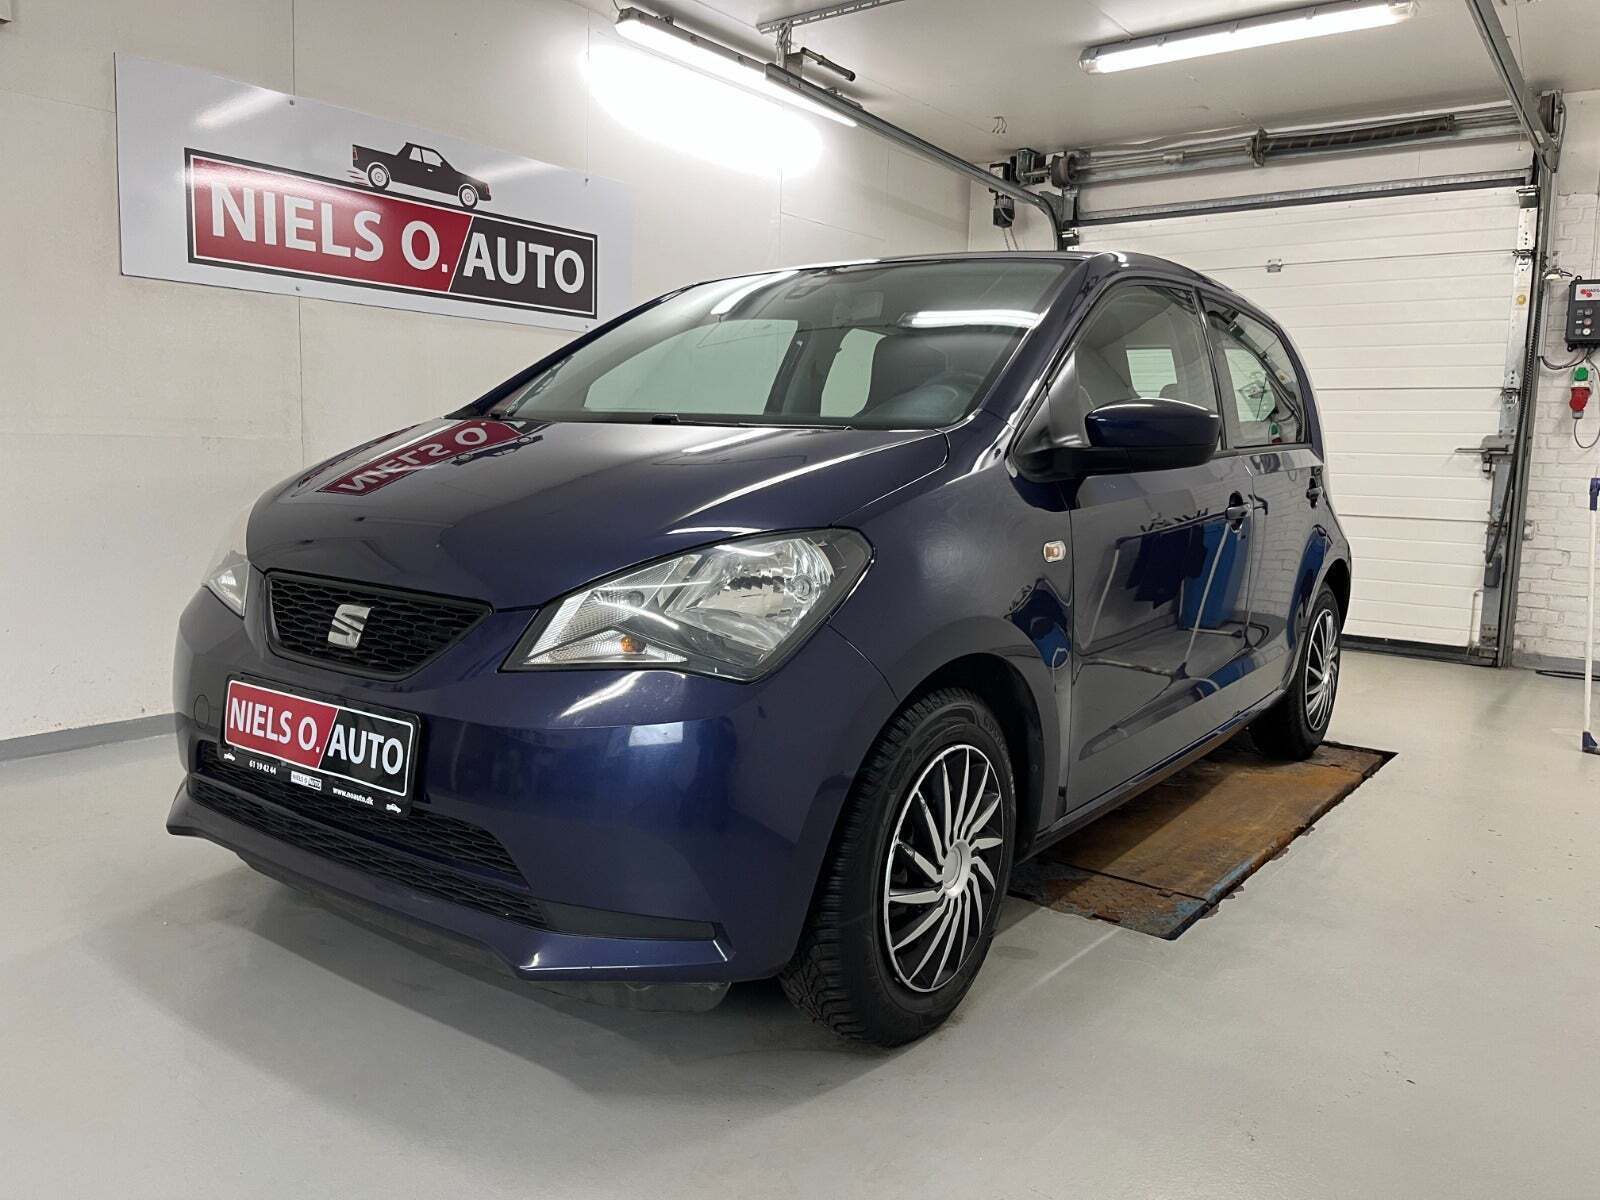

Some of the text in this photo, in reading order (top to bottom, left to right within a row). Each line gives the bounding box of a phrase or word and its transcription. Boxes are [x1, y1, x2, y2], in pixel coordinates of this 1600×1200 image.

[211, 182, 585, 294] NIELS O. AUTO
[230, 697, 404, 775] NIELS O. AUTO
